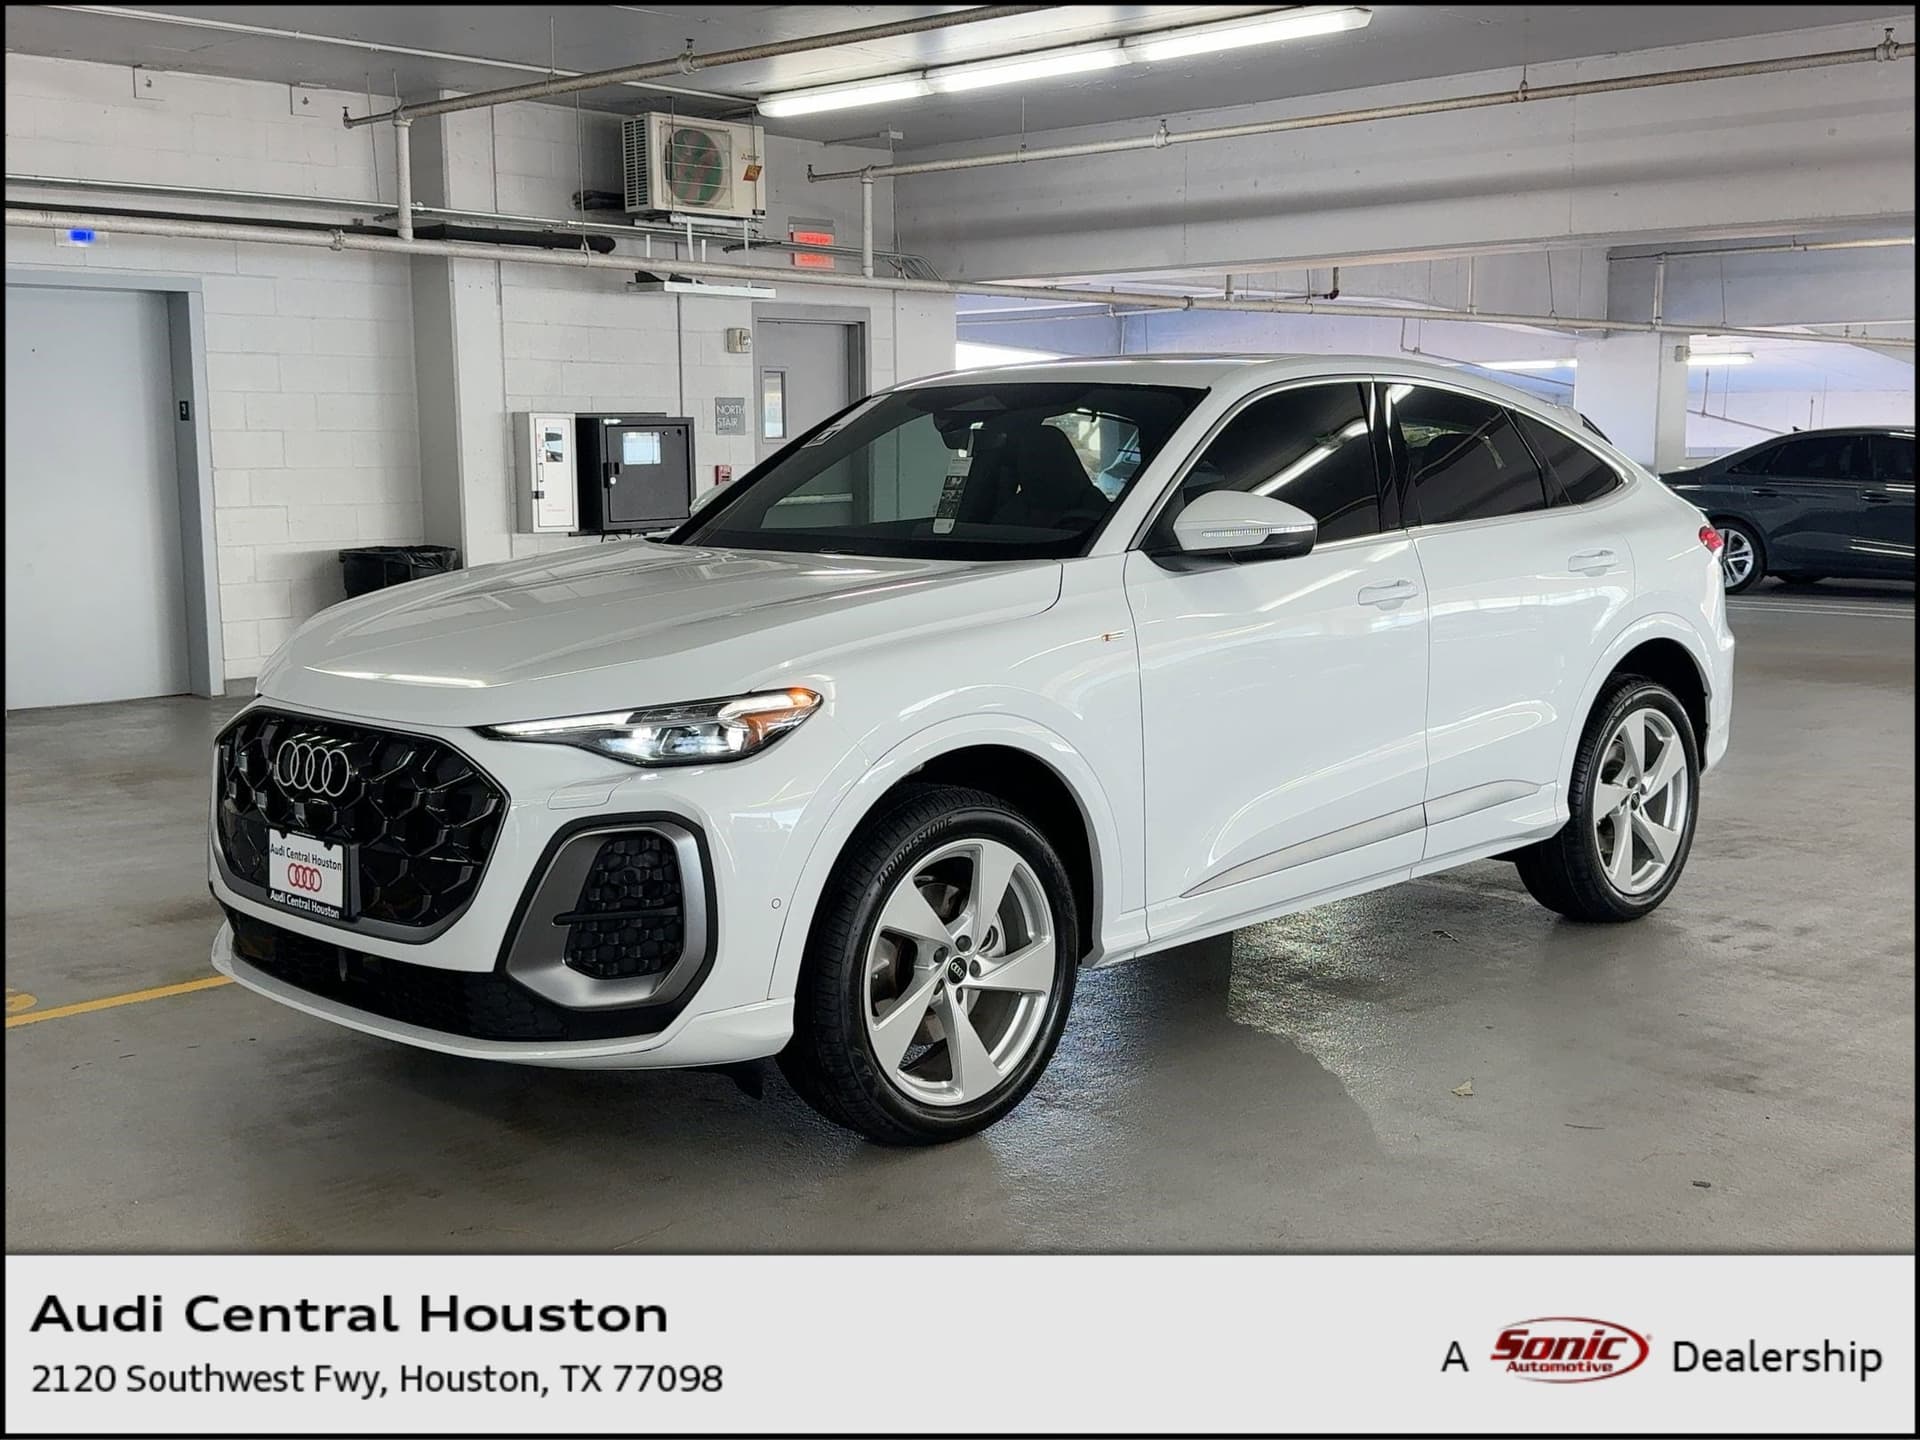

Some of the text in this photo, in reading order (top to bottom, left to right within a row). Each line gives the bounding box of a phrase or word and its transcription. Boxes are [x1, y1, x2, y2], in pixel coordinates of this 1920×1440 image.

[717, 404, 745, 416] NORTH
[717, 417, 738, 429] STAIR
[270, 843, 342, 872] Audi Central Houston
[878, 815, 953, 887] BRIDGESTONE
[270, 889, 340, 919] Audi Central Houston
